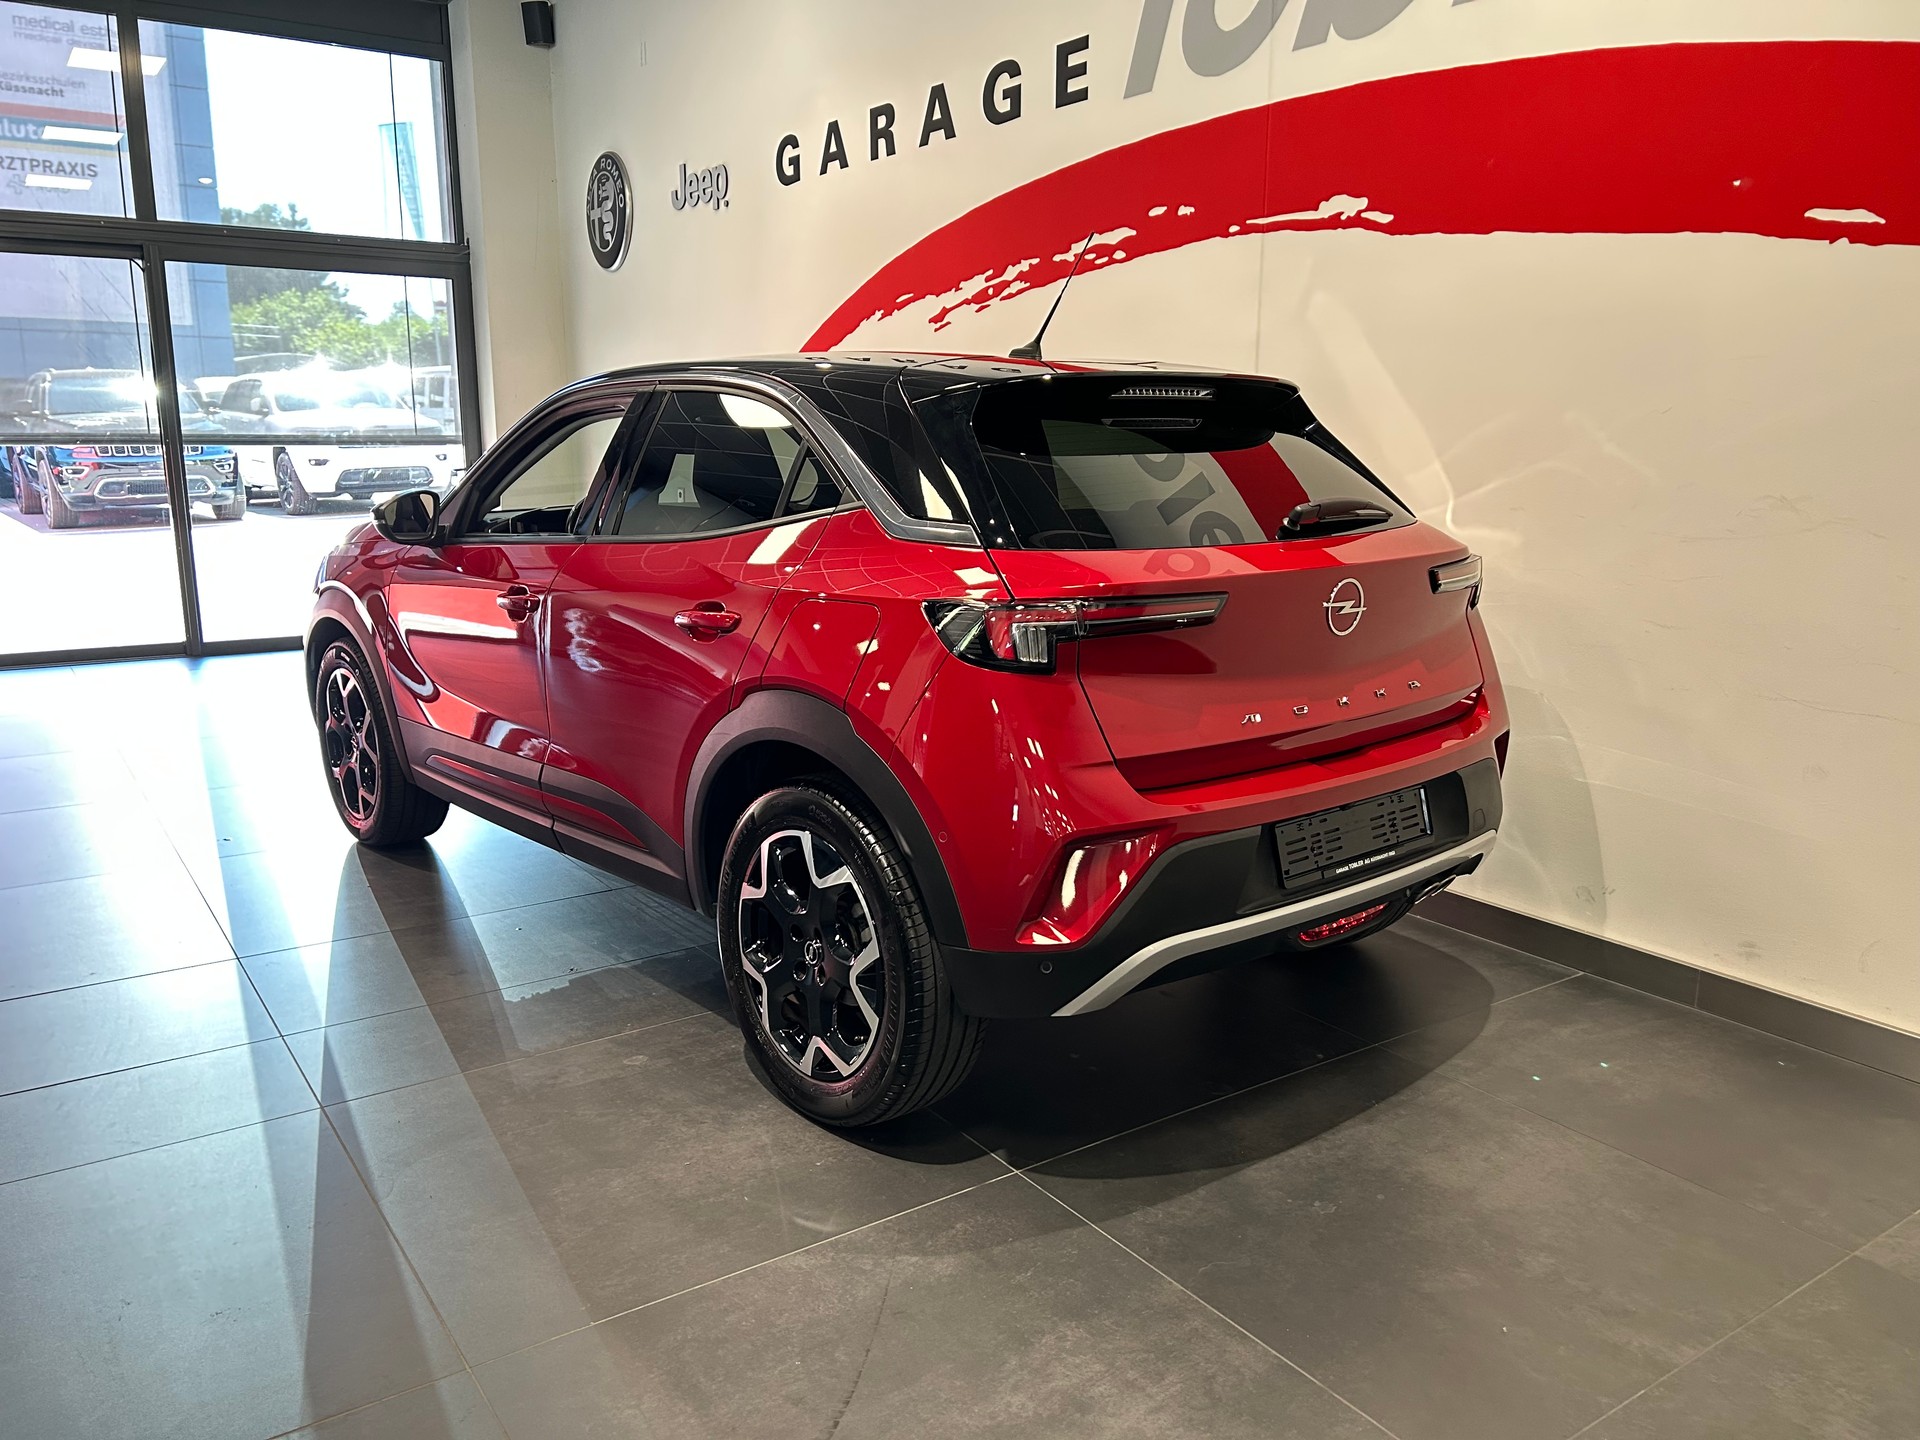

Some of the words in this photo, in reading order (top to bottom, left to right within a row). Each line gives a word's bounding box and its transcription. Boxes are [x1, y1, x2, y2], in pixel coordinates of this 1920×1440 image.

[12, 14, 74, 33] medical
[775, 34, 1090, 187] GARAGE
[600, 158, 625, 208] ROMEO
